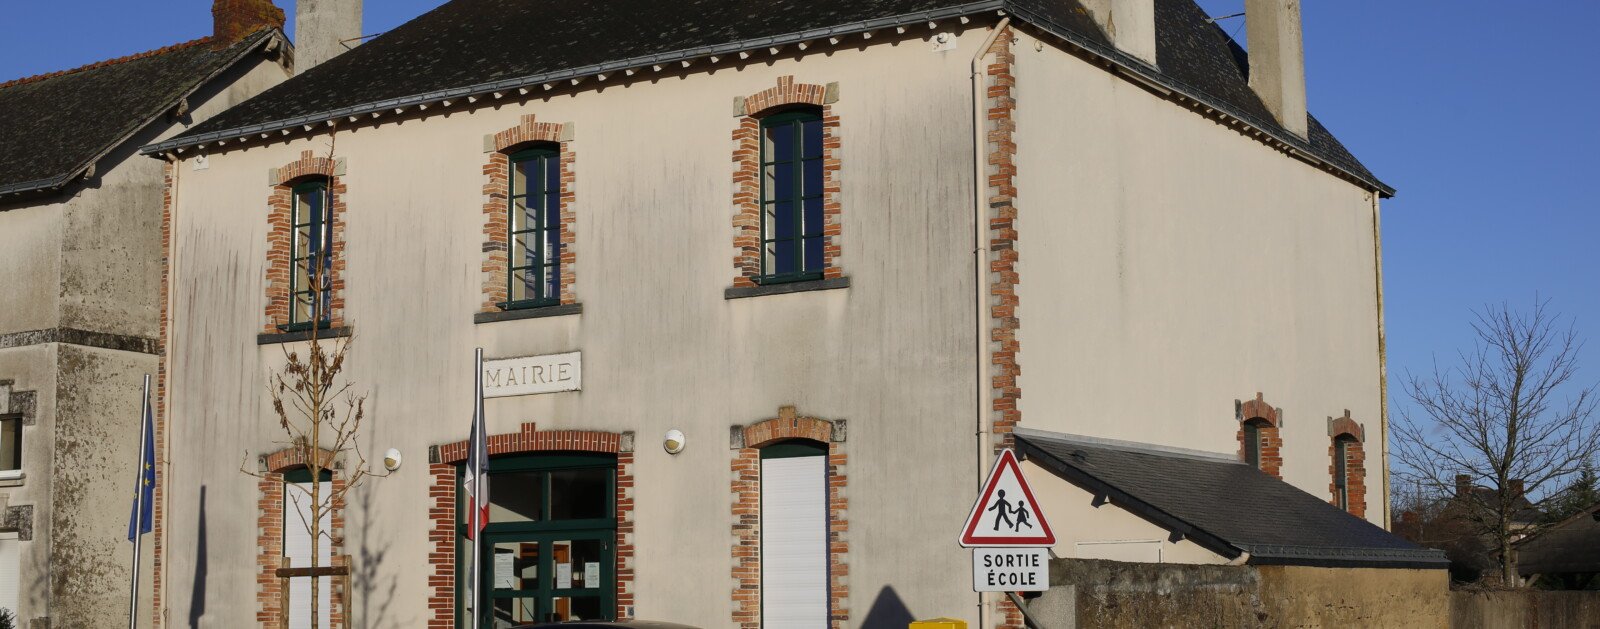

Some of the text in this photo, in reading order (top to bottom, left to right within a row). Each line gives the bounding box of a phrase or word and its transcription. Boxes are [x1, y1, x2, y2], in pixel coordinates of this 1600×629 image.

[485, 362, 572, 388] MAIRIE
[983, 554, 1039, 567] SORTIE
[987, 569, 1036, 586] ÉCOLE
